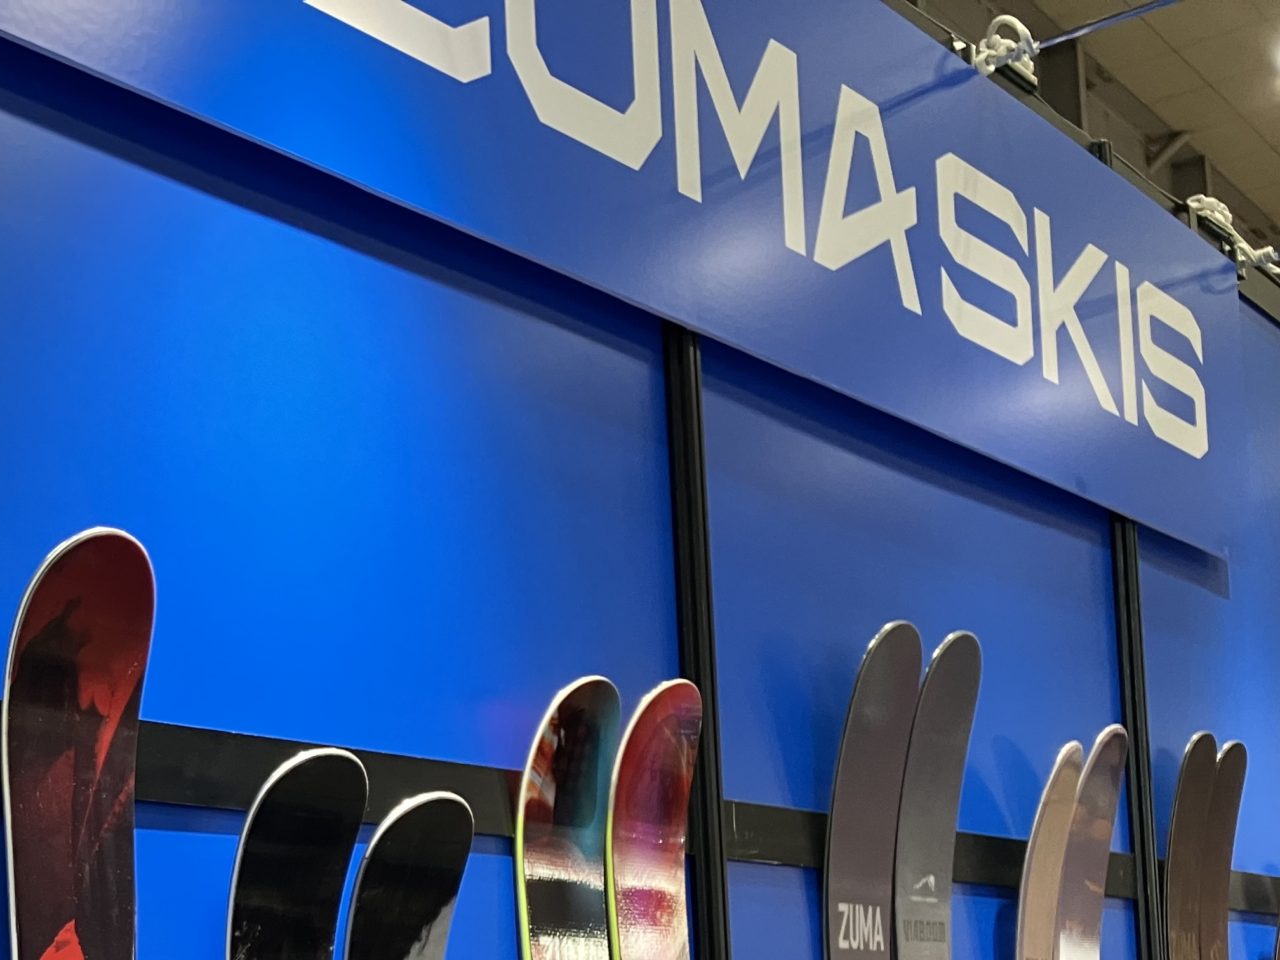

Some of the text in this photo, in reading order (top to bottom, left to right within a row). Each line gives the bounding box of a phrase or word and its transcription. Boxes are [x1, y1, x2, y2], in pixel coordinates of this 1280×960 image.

[303, 0, 1209, 460] UMA SKIS
[838, 902, 884, 951] ZUMA
